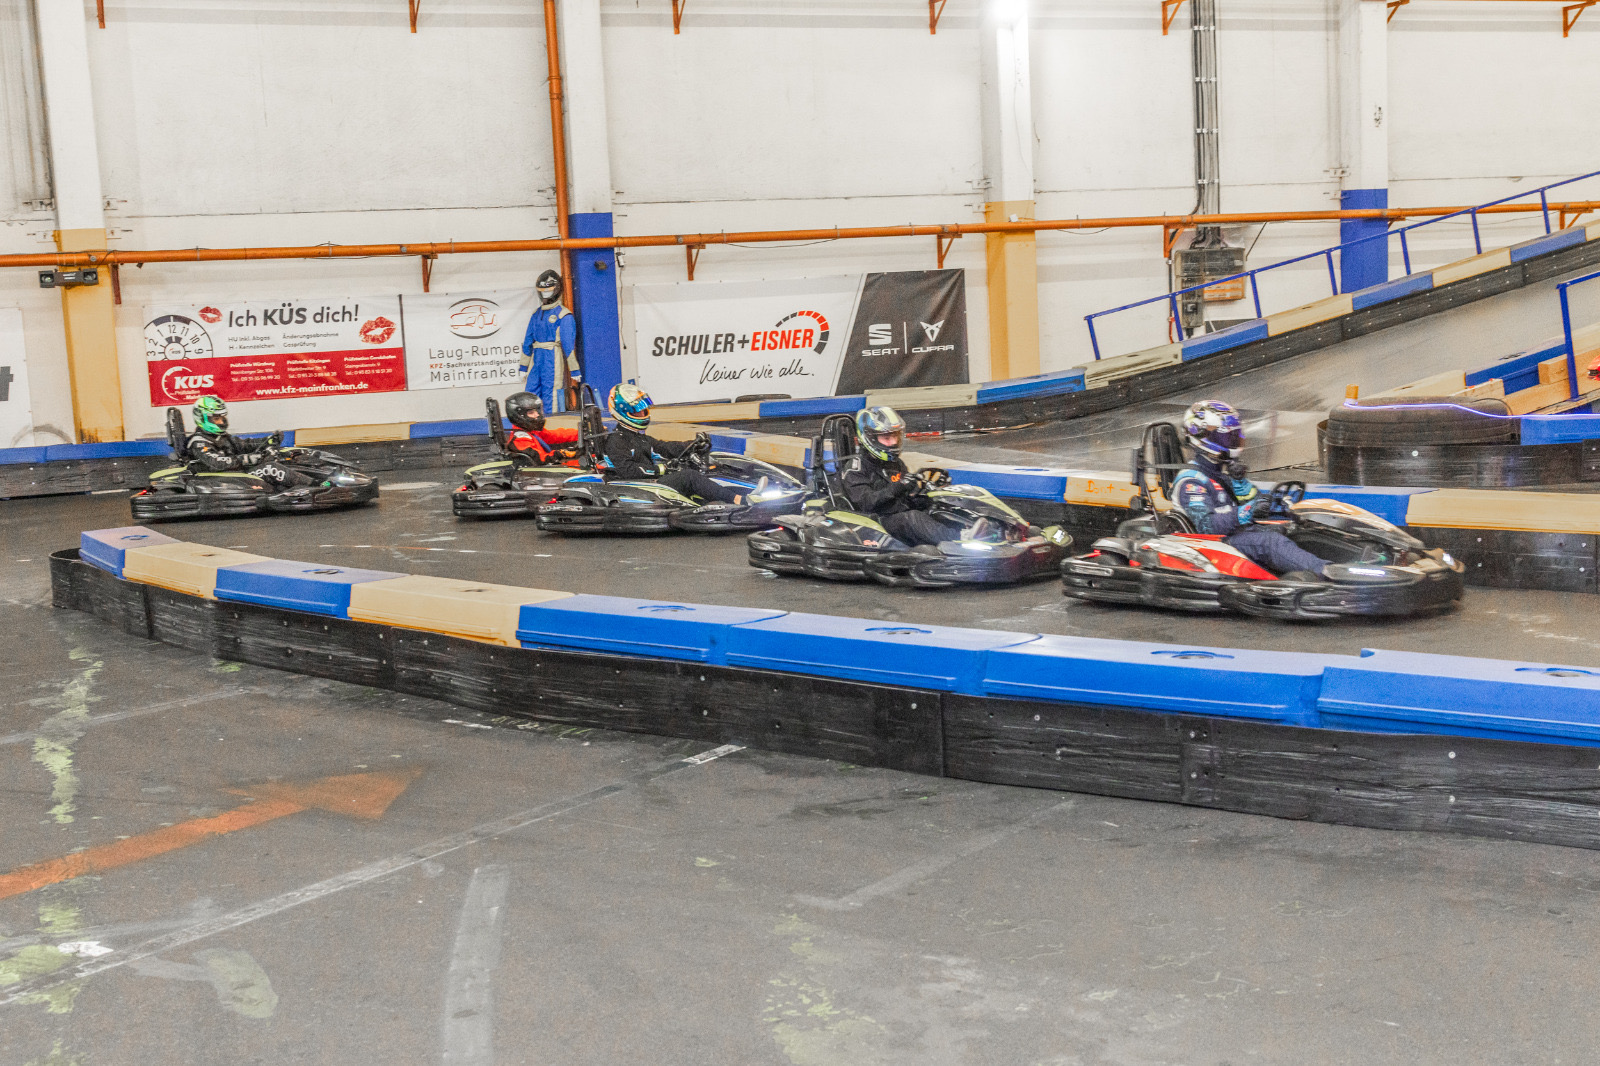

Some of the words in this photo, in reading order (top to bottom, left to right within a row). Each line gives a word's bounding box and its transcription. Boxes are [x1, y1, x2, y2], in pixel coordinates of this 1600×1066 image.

[228, 309, 257, 328] Ich
[263, 302, 308, 326] KÜS
[312, 304, 359, 324] dich!
[168, 324, 177, 334] 12
[180, 326, 190, 337] 11
[861, 347, 900, 357] SEAT
[911, 344, 955, 353] CUPRA
[429, 359, 520, 369] KFZ-Sachverständigenbür
[700, 359, 747, 384] Keiner
[750, 364, 773, 379] wie
[779, 358, 815, 378] alle.
[174, 374, 215, 389] KÜS
[256, 381, 369, 395] www.kfz-mainfranken.de
